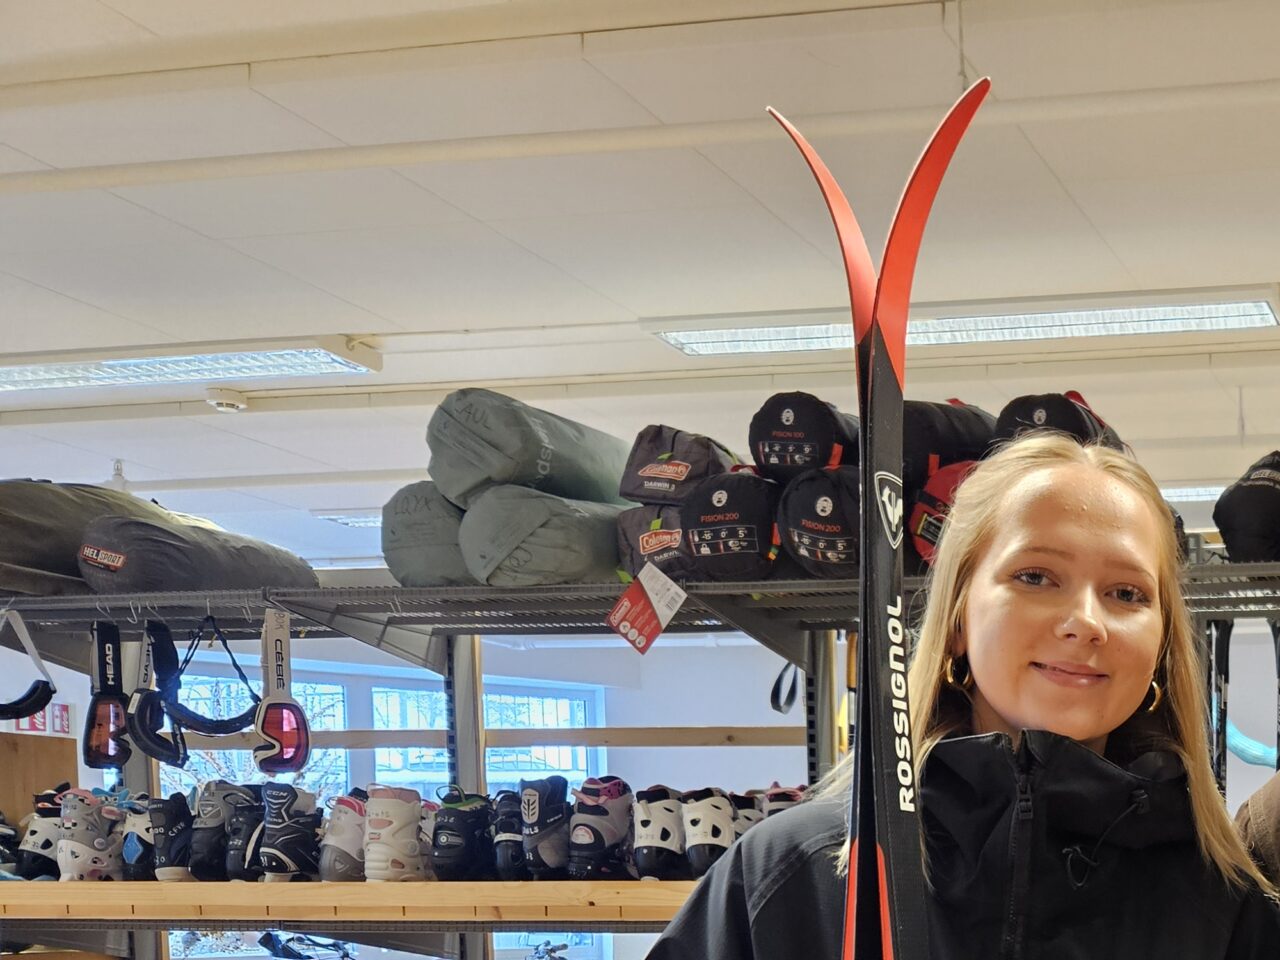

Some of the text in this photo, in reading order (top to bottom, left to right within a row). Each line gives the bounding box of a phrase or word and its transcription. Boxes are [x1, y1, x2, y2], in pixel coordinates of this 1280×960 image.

[105, 642, 115, 686] HEAD
[886, 595, 916, 813] ROSSIGNOL
[266, 789, 288, 797] CCM
